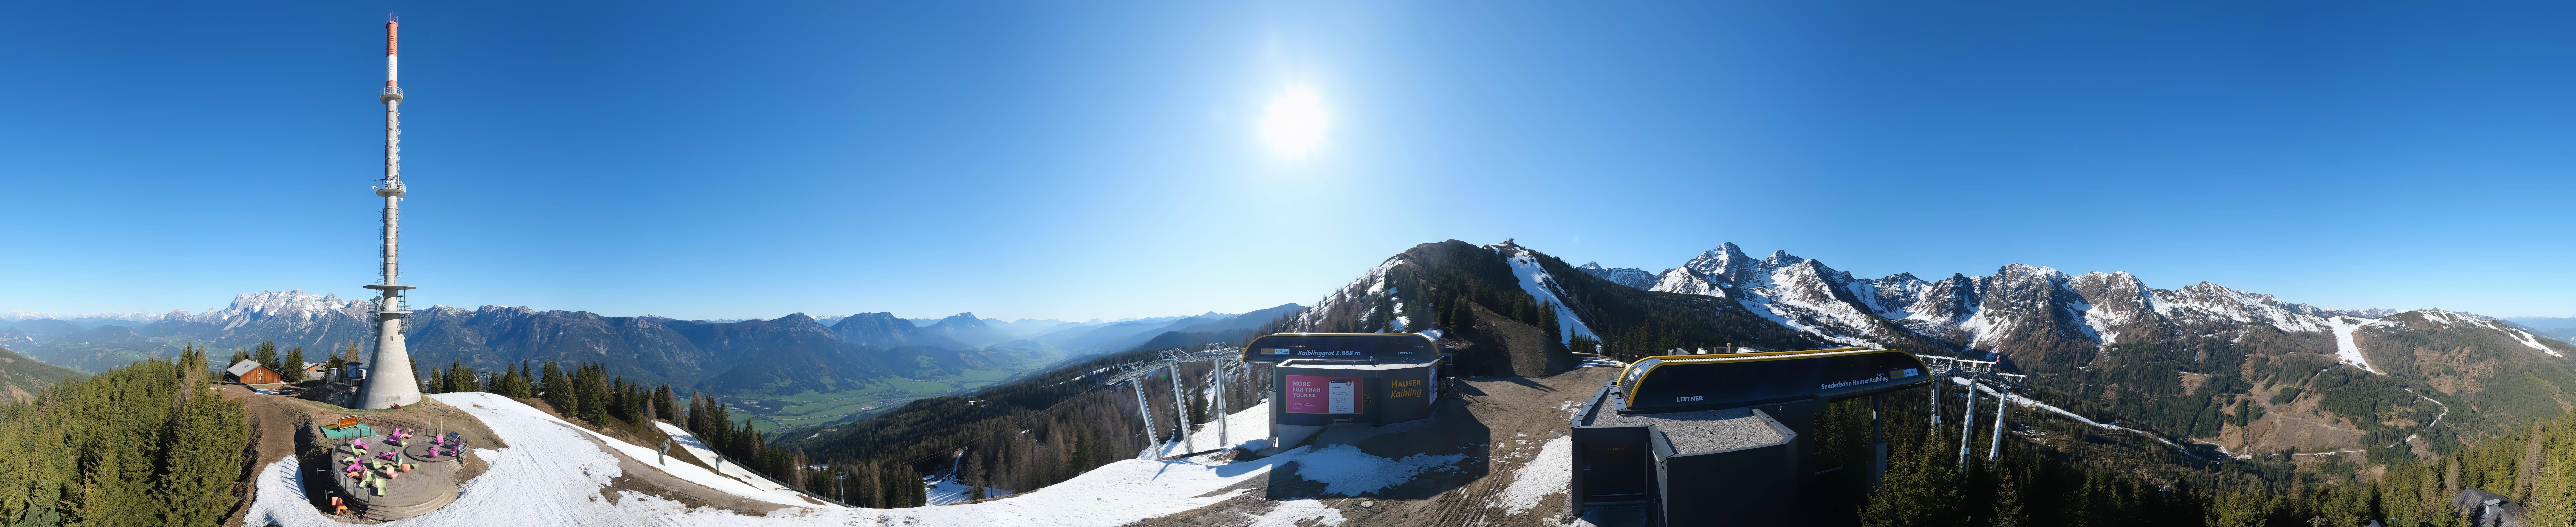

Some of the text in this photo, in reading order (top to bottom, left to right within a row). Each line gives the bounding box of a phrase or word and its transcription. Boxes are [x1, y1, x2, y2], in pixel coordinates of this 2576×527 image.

[1391, 379, 1421, 388] HAUSER
[1821, 381, 1852, 389] Senderbahn
[1391, 388, 1421, 398] Kaibling
